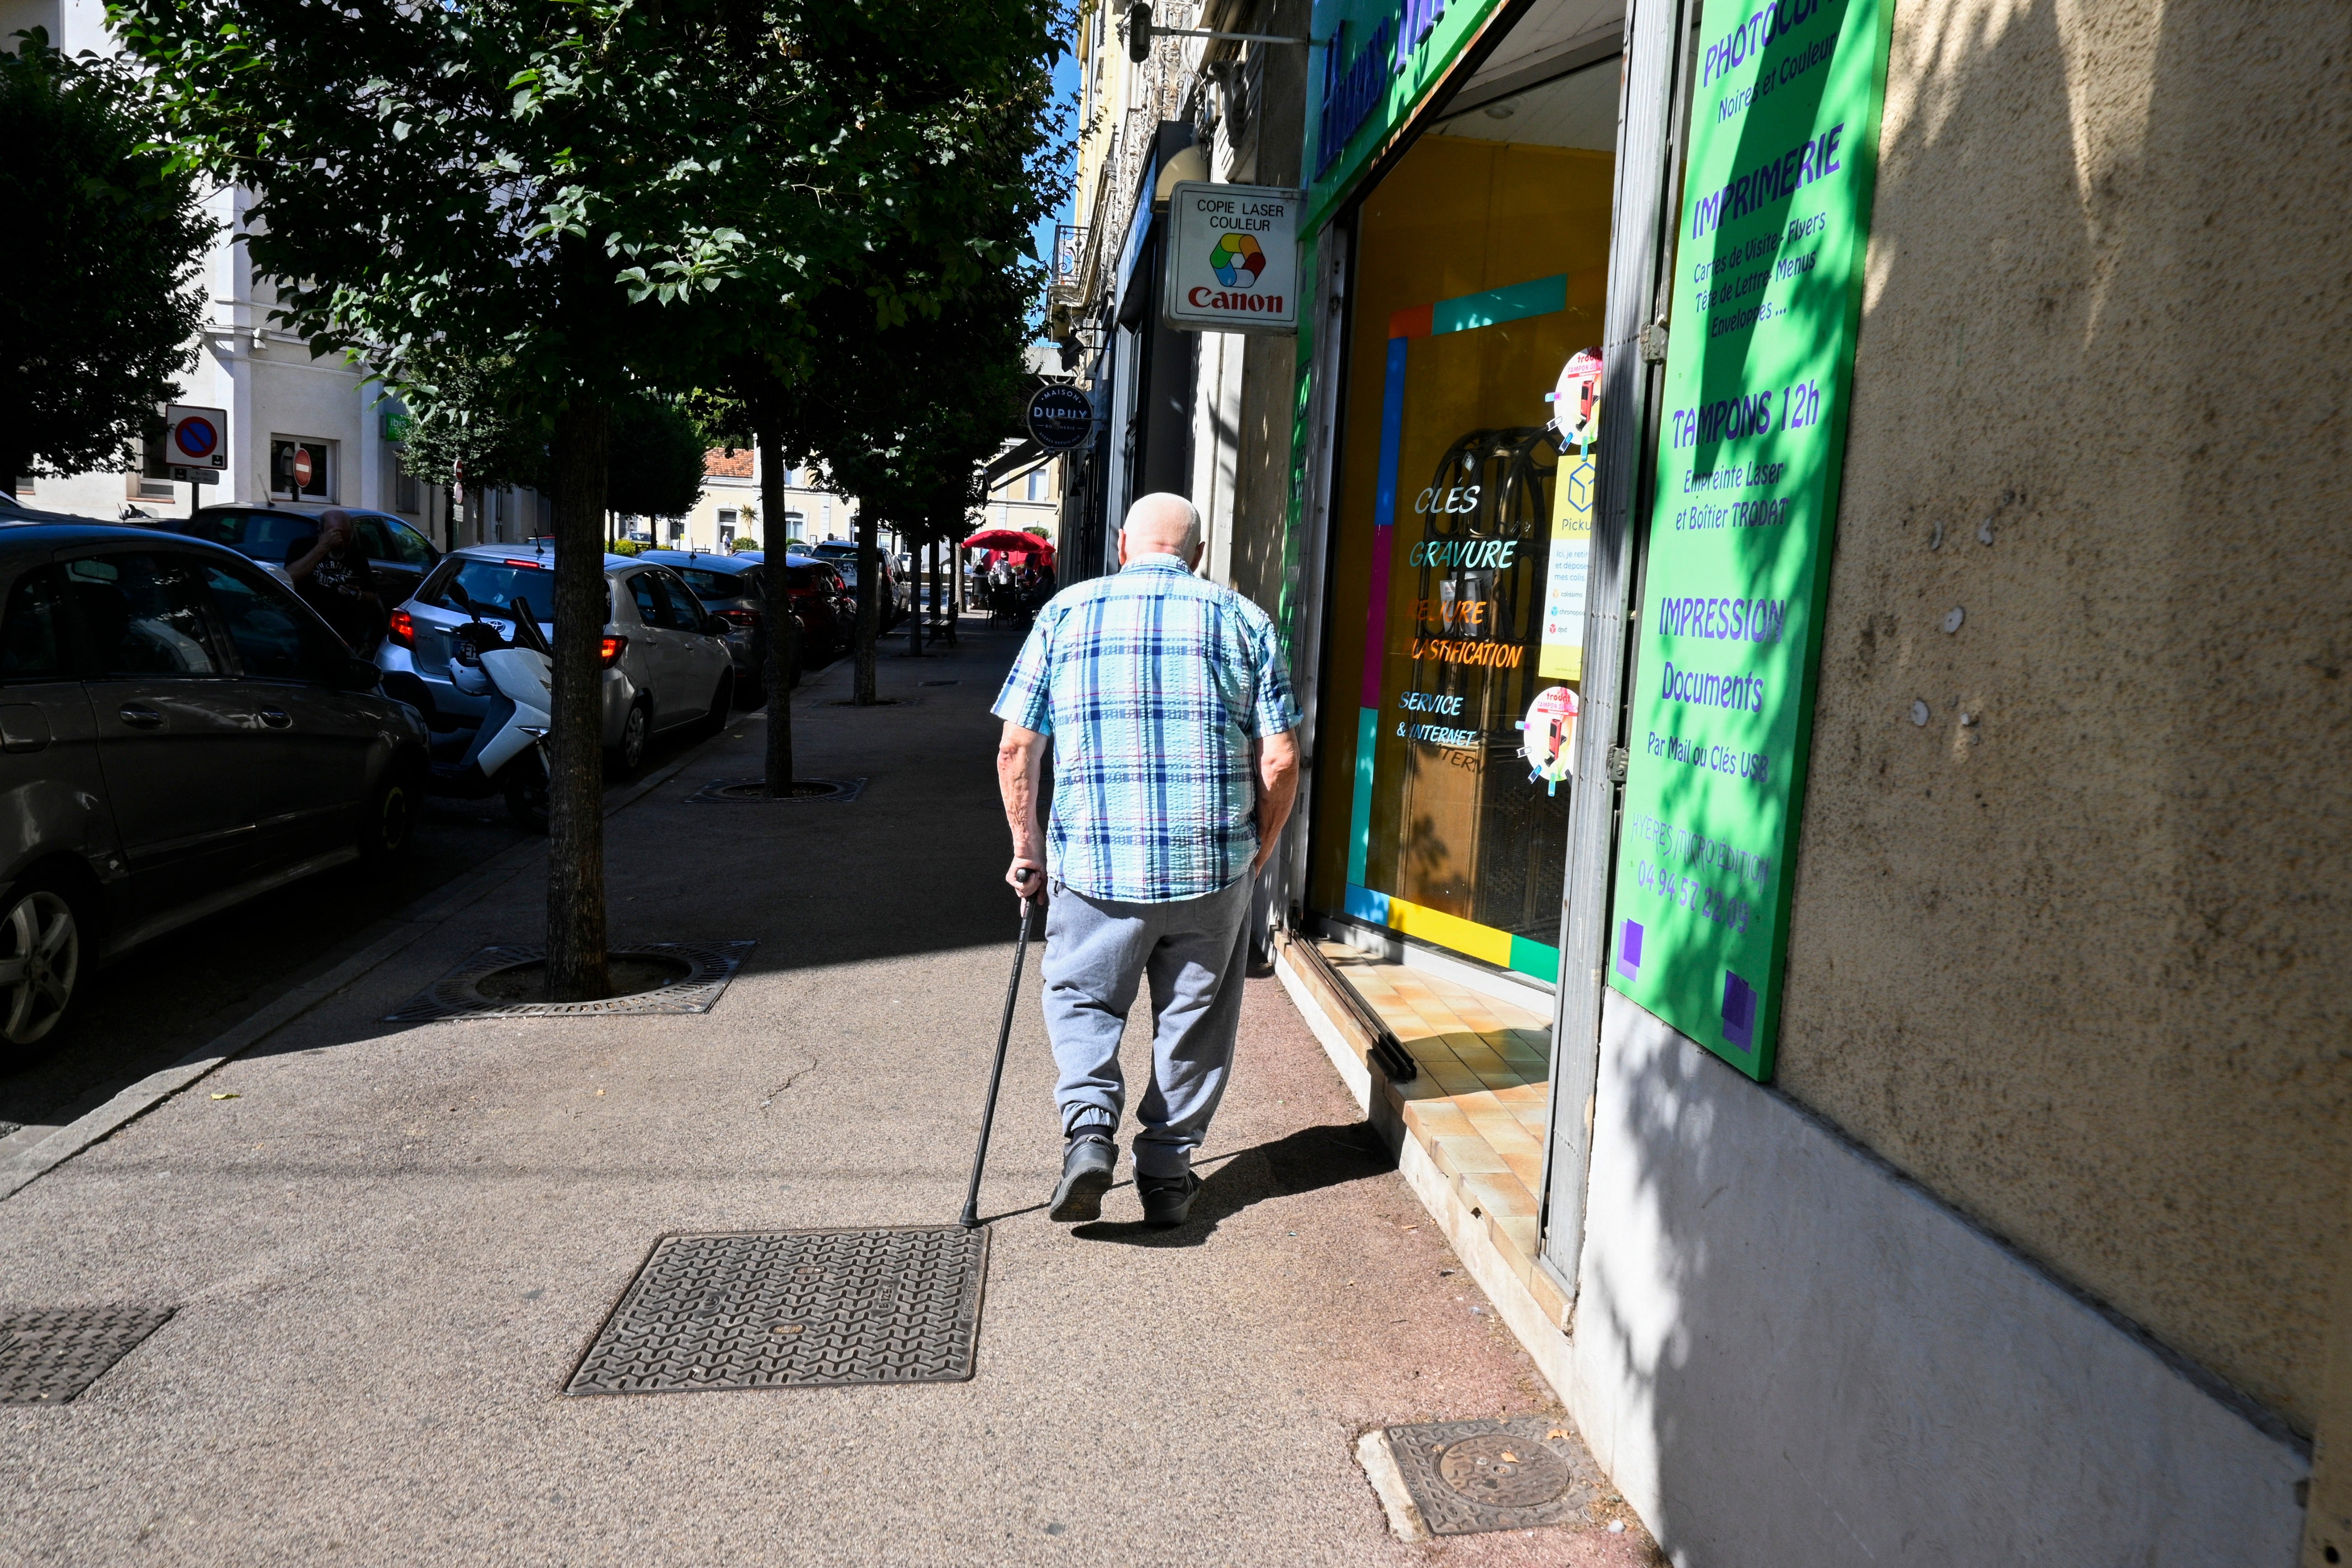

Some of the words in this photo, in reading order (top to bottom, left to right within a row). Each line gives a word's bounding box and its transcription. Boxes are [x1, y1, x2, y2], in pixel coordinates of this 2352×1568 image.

[1718, 82, 1759, 123] Noires
[1763, 66, 1777, 96] et
[1780, 32, 1836, 85] Couleur
[1692, 123, 1844, 239] IMPRIMERIE
[1197, 199, 1235, 213] COPIE
[1242, 203, 1284, 217] LASER
[1210, 216, 1270, 231] COULEUR
[1694, 255, 1726, 284] Cartes
[1729, 246, 1742, 268] de
[1745, 232, 1777, 266] Visite
[1788, 212, 1826, 245] Flyers
[1695, 289, 1717, 313] Tête
[1719, 280, 1733, 301] de
[1775, 251, 1816, 282] Menus
[1188, 287, 1283, 313] Canon
[1711, 302, 1772, 338] Enveloppes
[1568, 364, 1589, 373] TAMPON
[1044, 389, 1080, 401] MAISON
[390, 418, 406, 427] ibis
[1034, 407, 1088, 419] DUPUY
[1672, 390, 1772, 449] TAMPONS
[1780, 379, 1820, 432] 12h
[1684, 464, 1743, 493] Empreinte
[1745, 461, 1784, 487] Laser
[1414, 477, 1481, 514] CLÉS
[1676, 511, 1687, 531] et
[1689, 503, 1729, 530] Boîtier
[1732, 497, 1788, 528] TRODAT
[1409, 540, 1518, 569] GRAVURE
[1566, 550, 1573, 559] je
[1406, 599, 1486, 625] RELIURE
[1659, 597, 1785, 643] IMPRESSION
[1403, 637, 1523, 669] PLASTIFICATION
[1547, 692, 1571, 702] trodat
[1662, 661, 1763, 713] Documents
[1398, 691, 1463, 716] SERVICE
[1397, 722, 1406, 737] &
[1409, 724, 1477, 746] INTERNET
[1648, 731, 1665, 757] Par
[1668, 735, 1690, 763] Mail
[1693, 744, 1707, 768] ou
[1711, 745, 1736, 775] Clés
[1740, 751, 1769, 783] USB
[1630, 811, 1673, 857] HYÈRES
[1638, 860, 1654, 892] 04
[1659, 868, 1676, 901] 94
[1679, 876, 1700, 912] 57
[1701, 886, 1724, 923] 22
[1726, 897, 1750, 933] 09
